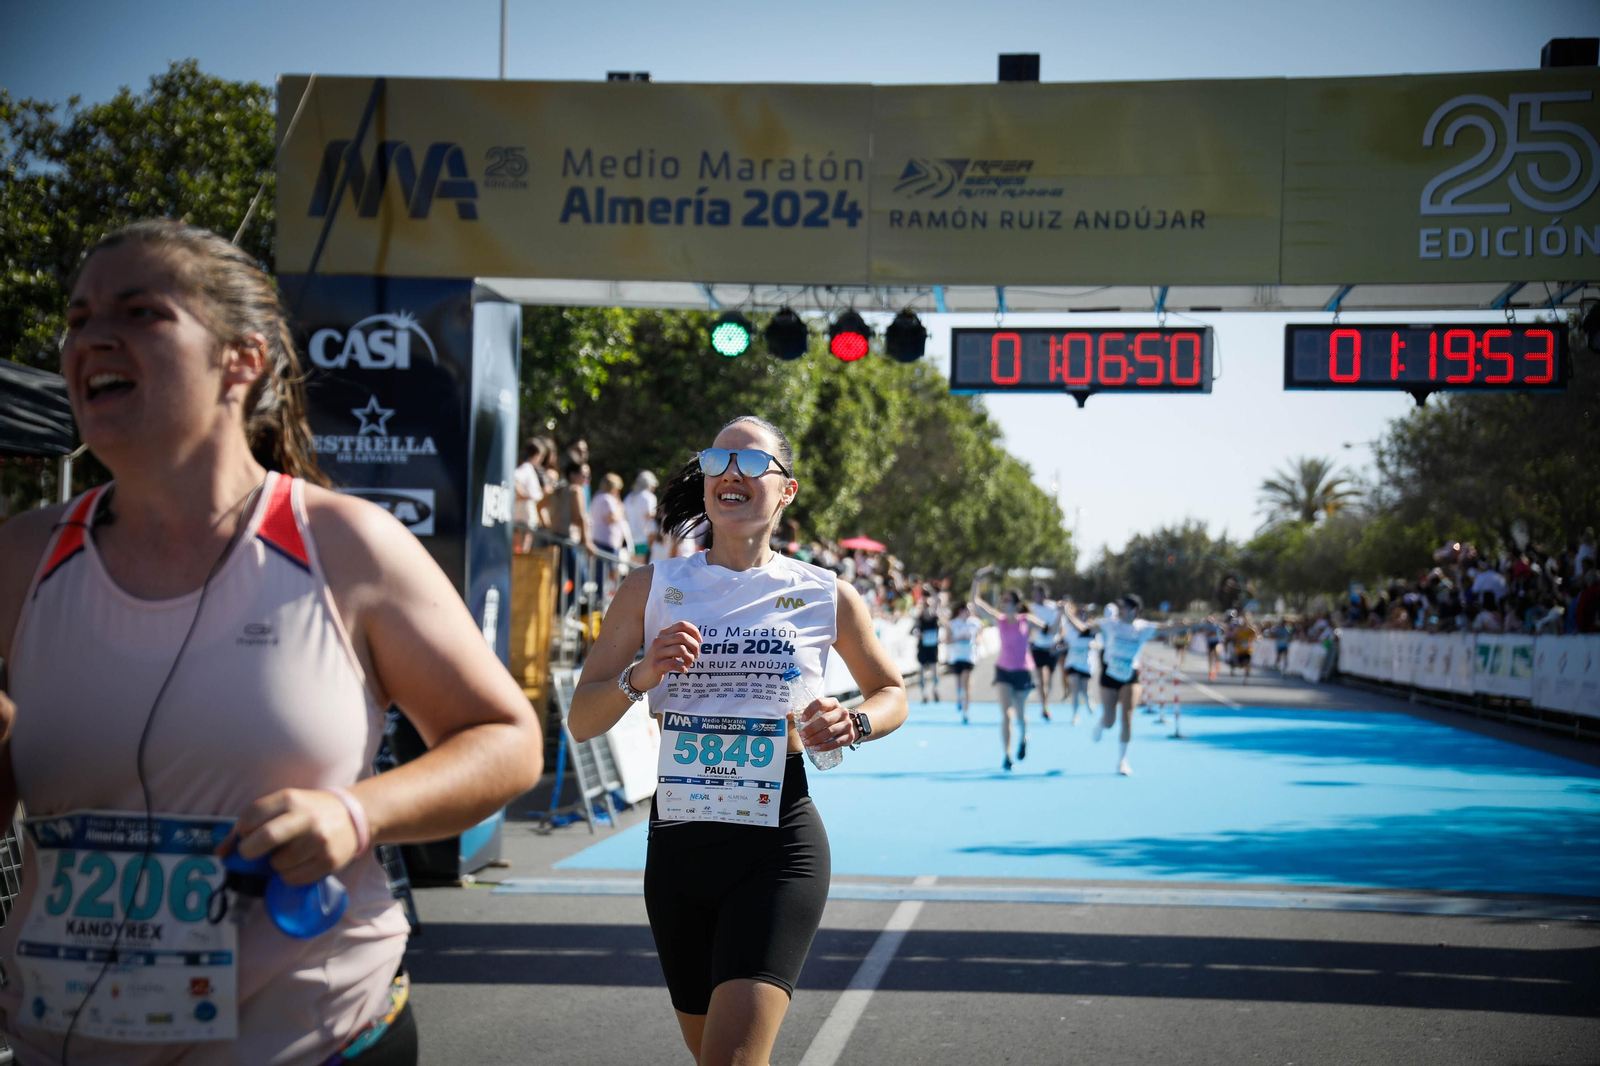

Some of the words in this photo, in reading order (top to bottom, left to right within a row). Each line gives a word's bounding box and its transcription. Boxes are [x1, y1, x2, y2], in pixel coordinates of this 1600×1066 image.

[484, 146, 528, 178] 25
[561, 148, 680, 179] Medio
[698, 150, 864, 182] Maratón
[1420, 91, 1600, 215] 25
[559, 185, 732, 227] Almería
[741, 189, 863, 228] 2024
[889, 205, 988, 230] RAMÓN
[1000, 209, 1063, 230] RUIZ
[1073, 205, 1206, 230] ANDÚJAR
[1420, 217, 1600, 259] EDICIÓN
[308, 328, 411, 370] CASI
[309, 435, 437, 455] ESTRELLA
[664, 586, 684, 601] 25
[725, 626, 797, 639] Maratón
[700, 639, 739, 654] ería
[743, 639, 796, 656] 2024
[709, 660, 737, 669] RUIZ
[740, 659, 796, 670] ANDÚJAR
[727, 723, 746, 731] 2024
[673, 732, 775, 768] 5849
[704, 766, 737, 776] PAULA
[44, 851, 217, 922] 5206
[65, 920, 163, 940] KANDYREX
